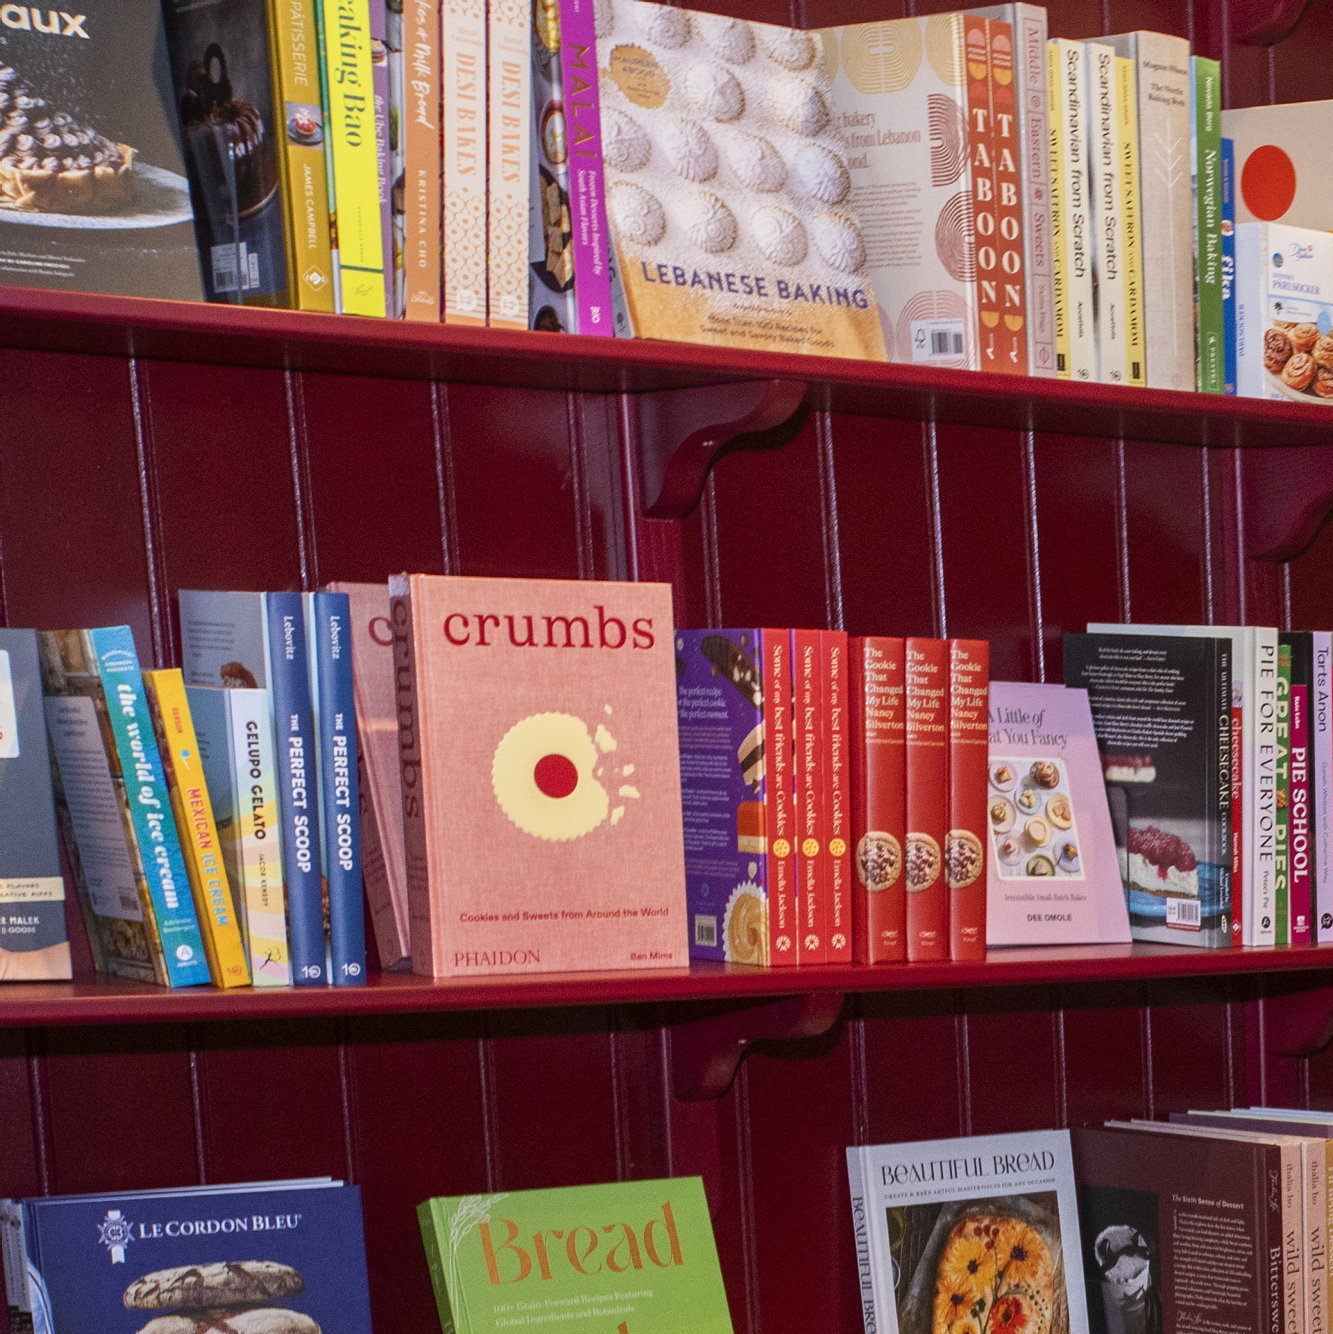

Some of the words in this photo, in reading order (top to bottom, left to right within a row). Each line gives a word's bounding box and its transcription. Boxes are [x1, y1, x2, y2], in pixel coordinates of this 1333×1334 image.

[455, 52, 477, 102] DESI
[1027, 27, 1040, 84] Middle
[567, 44, 597, 160] MALAI
[1066, 49, 1082, 163] Scandinavian
[456, 108, 477, 176] BAKES
[1029, 118, 1042, 178] Eastern
[303, 164, 312, 197] JAMES
[417, 170, 427, 234] KRISTINA
[1069, 169, 1084, 208] from
[1203, 149, 1217, 232] Norwegian
[306, 199, 317, 249] CAMPBELL
[972, 109, 998, 304] TABOON
[418, 240, 427, 268] CHO
[1032, 212, 1045, 267] Sweets
[1072, 213, 1087, 279] Scratch
[1204, 235, 1219, 285] Baking
[640, 261, 768, 298] LEBANESE
[776, 280, 871, 309] BAKING
[443, 605, 655, 652] crumbs
[1260, 645, 1274, 678] PIE
[1316, 646, 1329, 687] Tarts
[115, 684, 137, 718] the
[291, 714, 299, 731] THE
[1260, 690, 1274, 734] FOR
[1318, 691, 1329, 732] Anon
[125, 722, 156, 782] world
[245, 721, 261, 780] GELUPO
[288, 736, 306, 810] PERFECT
[1231, 718, 1242, 800] cheesecake
[1292, 747, 1306, 782] PIE
[137, 785, 160, 806] of
[187, 787, 213, 850] MEXICAN
[251, 785, 266, 841] GELATO
[1259, 744, 1273, 862] EVERYONE
[146, 813, 164, 842] ice
[292, 815, 311, 873] SCOOP
[1292, 788, 1307, 883] SCHOOL
[153, 848, 179, 909] cream
[202, 853, 216, 876] ICE
[206, 878, 229, 926] CREAM
[459, 912, 500, 923] Cookies
[502, 911, 521, 922] and
[522, 910, 559, 922] Sweets
[560, 908, 584, 920] from
[586, 908, 621, 920] Around
[623, 907, 638, 918] the
[640, 906, 670, 918] World
[454, 948, 541, 968] PHAIDON
[630, 951, 646, 961] Ben
[647, 950, 673, 961] Mims
[881, 1153, 991, 1186] BEAUTIFUL
[993, 1150, 1055, 1175] BREAD
[139, 1222, 164, 1239] LE
[165, 1217, 249, 1238] CORDON
[252, 1214, 300, 1230] BLEU
[478, 1200, 685, 1287] Bread
[1285, 1230, 1299, 1275] wild
